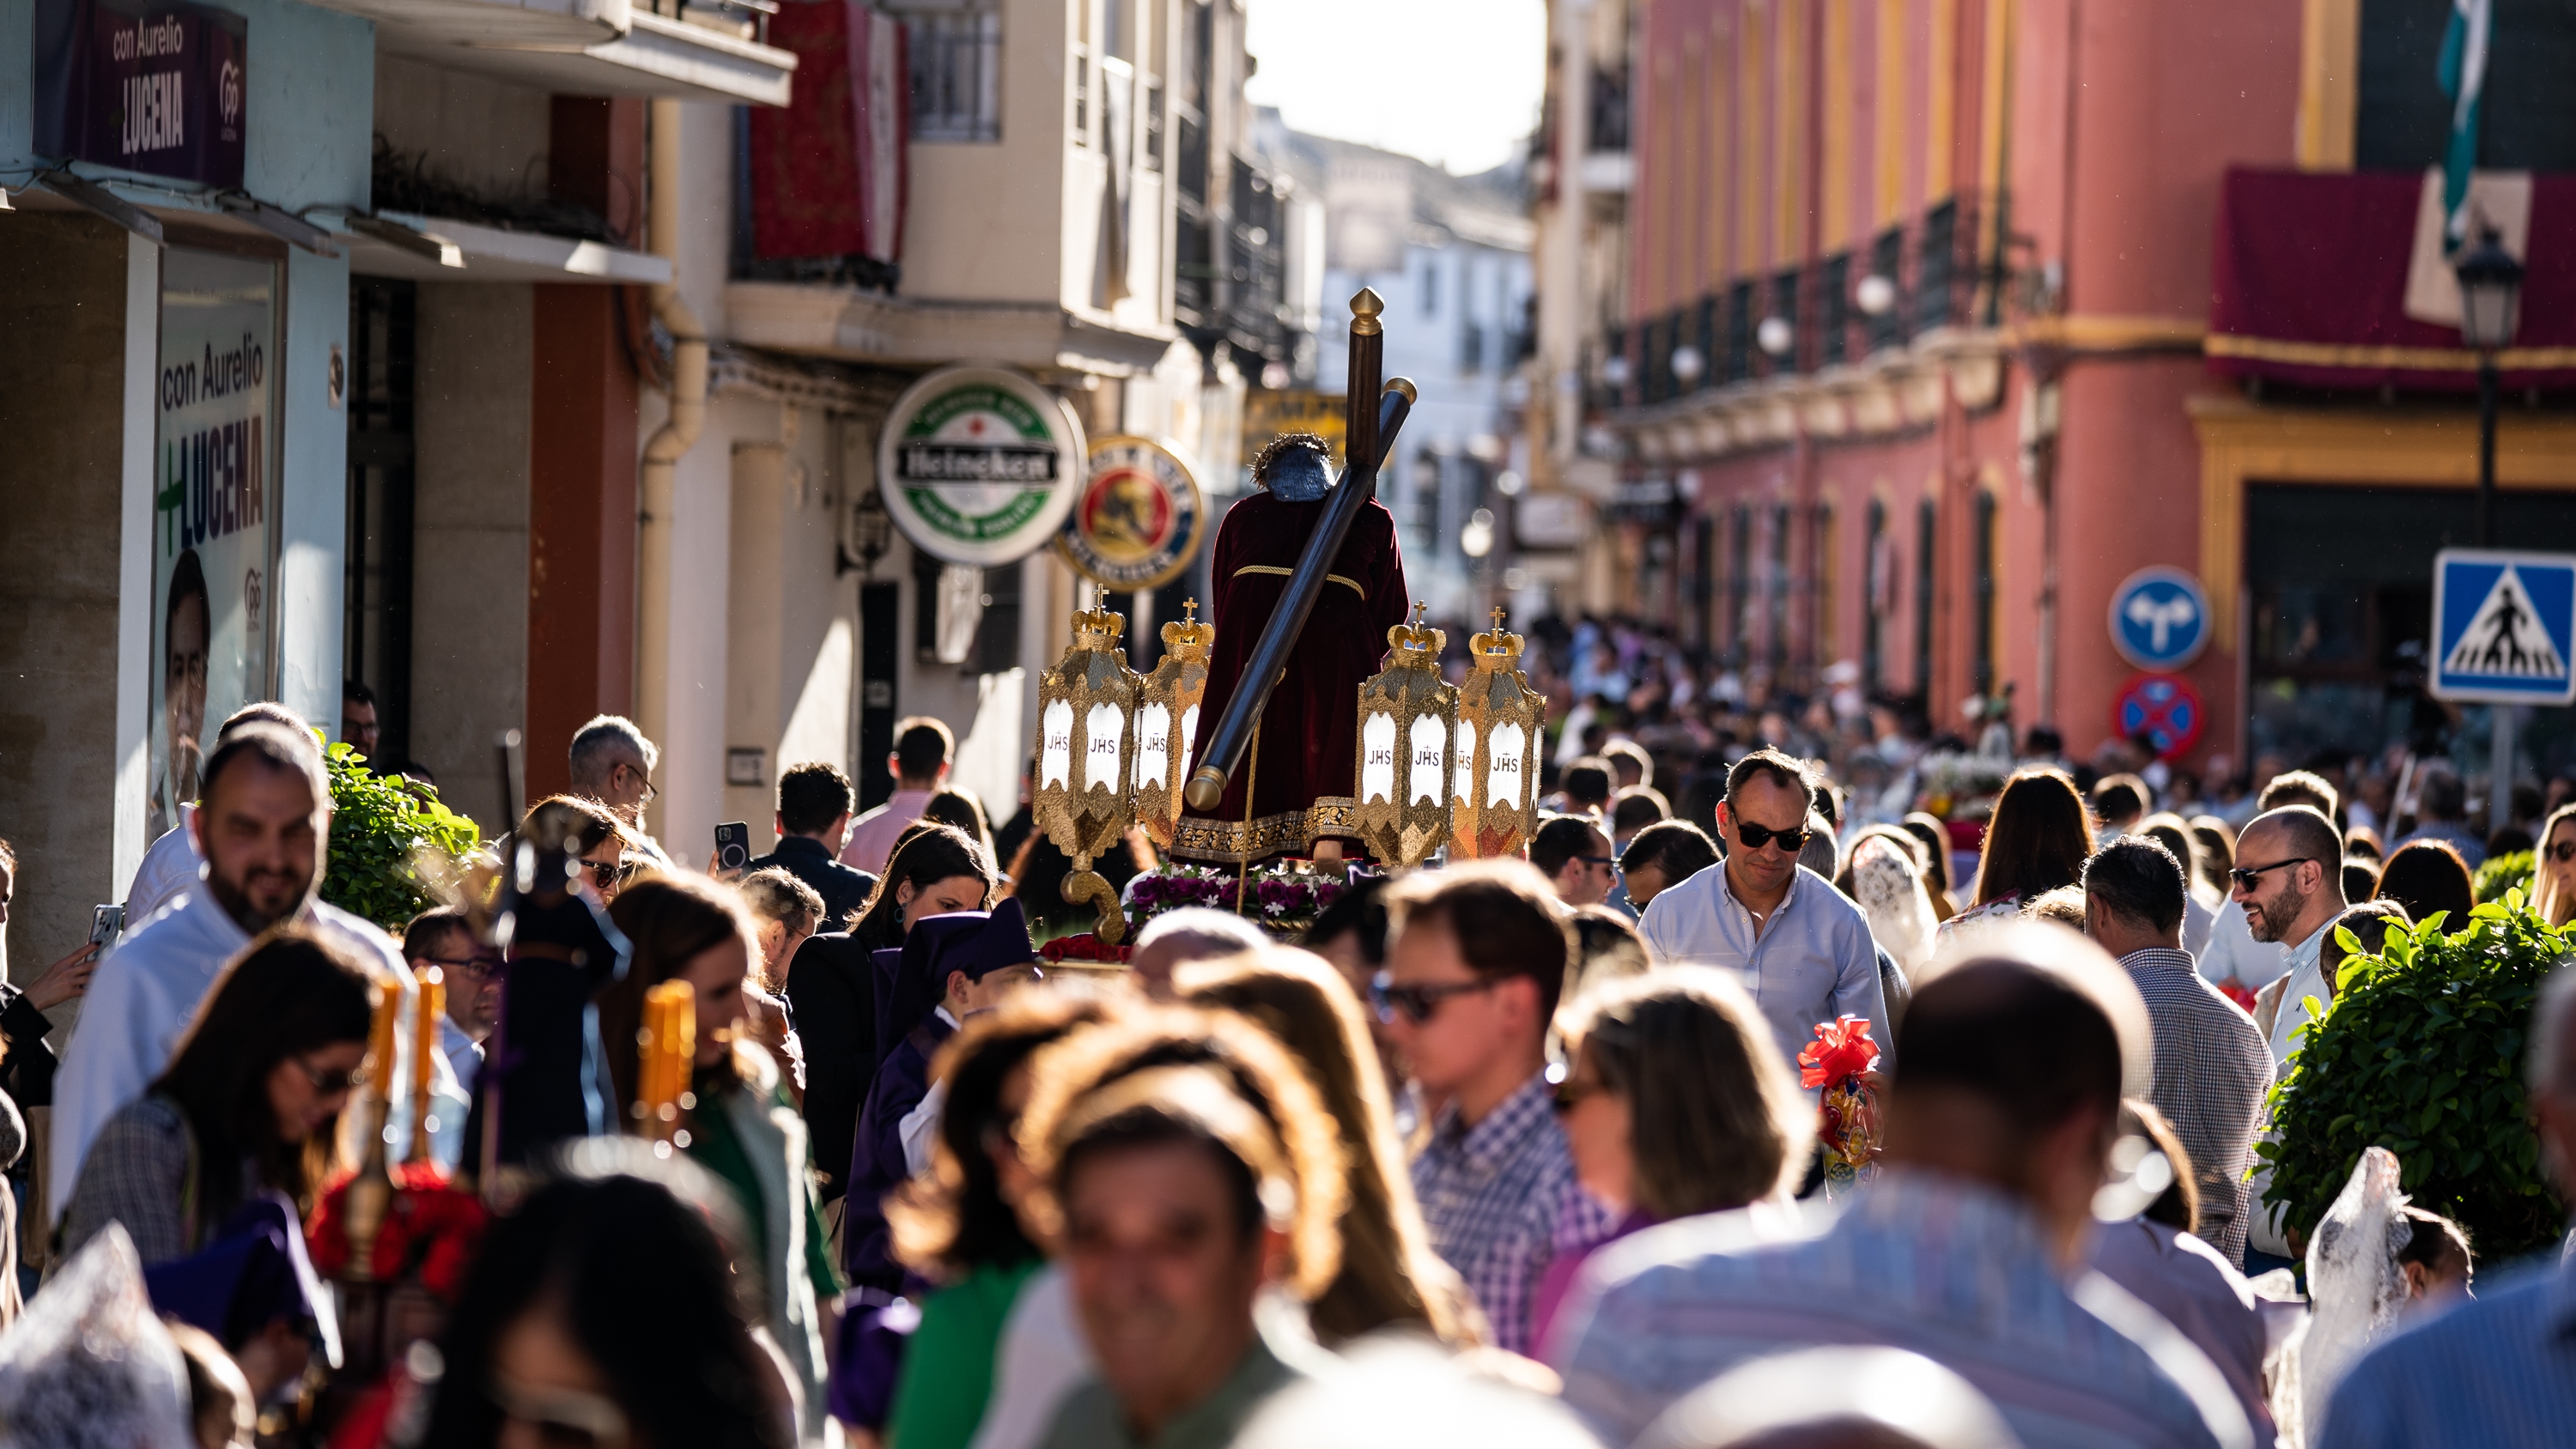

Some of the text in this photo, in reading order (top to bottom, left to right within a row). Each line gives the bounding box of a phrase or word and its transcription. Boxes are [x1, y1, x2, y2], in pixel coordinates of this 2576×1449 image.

[113, 13, 183, 62] con Aurelio
[162, 330, 263, 413] con Aurelio
[907, 446, 1050, 479] Heineken
[1048, 735, 1069, 751] JHS
[1090, 738, 1115, 755] JHS
[1146, 737, 1166, 752] JHS
[1368, 749, 1391, 765] JHS
[1415, 750, 1439, 767] JHS
[1457, 755, 1471, 771] HS
[1492, 756, 1518, 773] JHS
